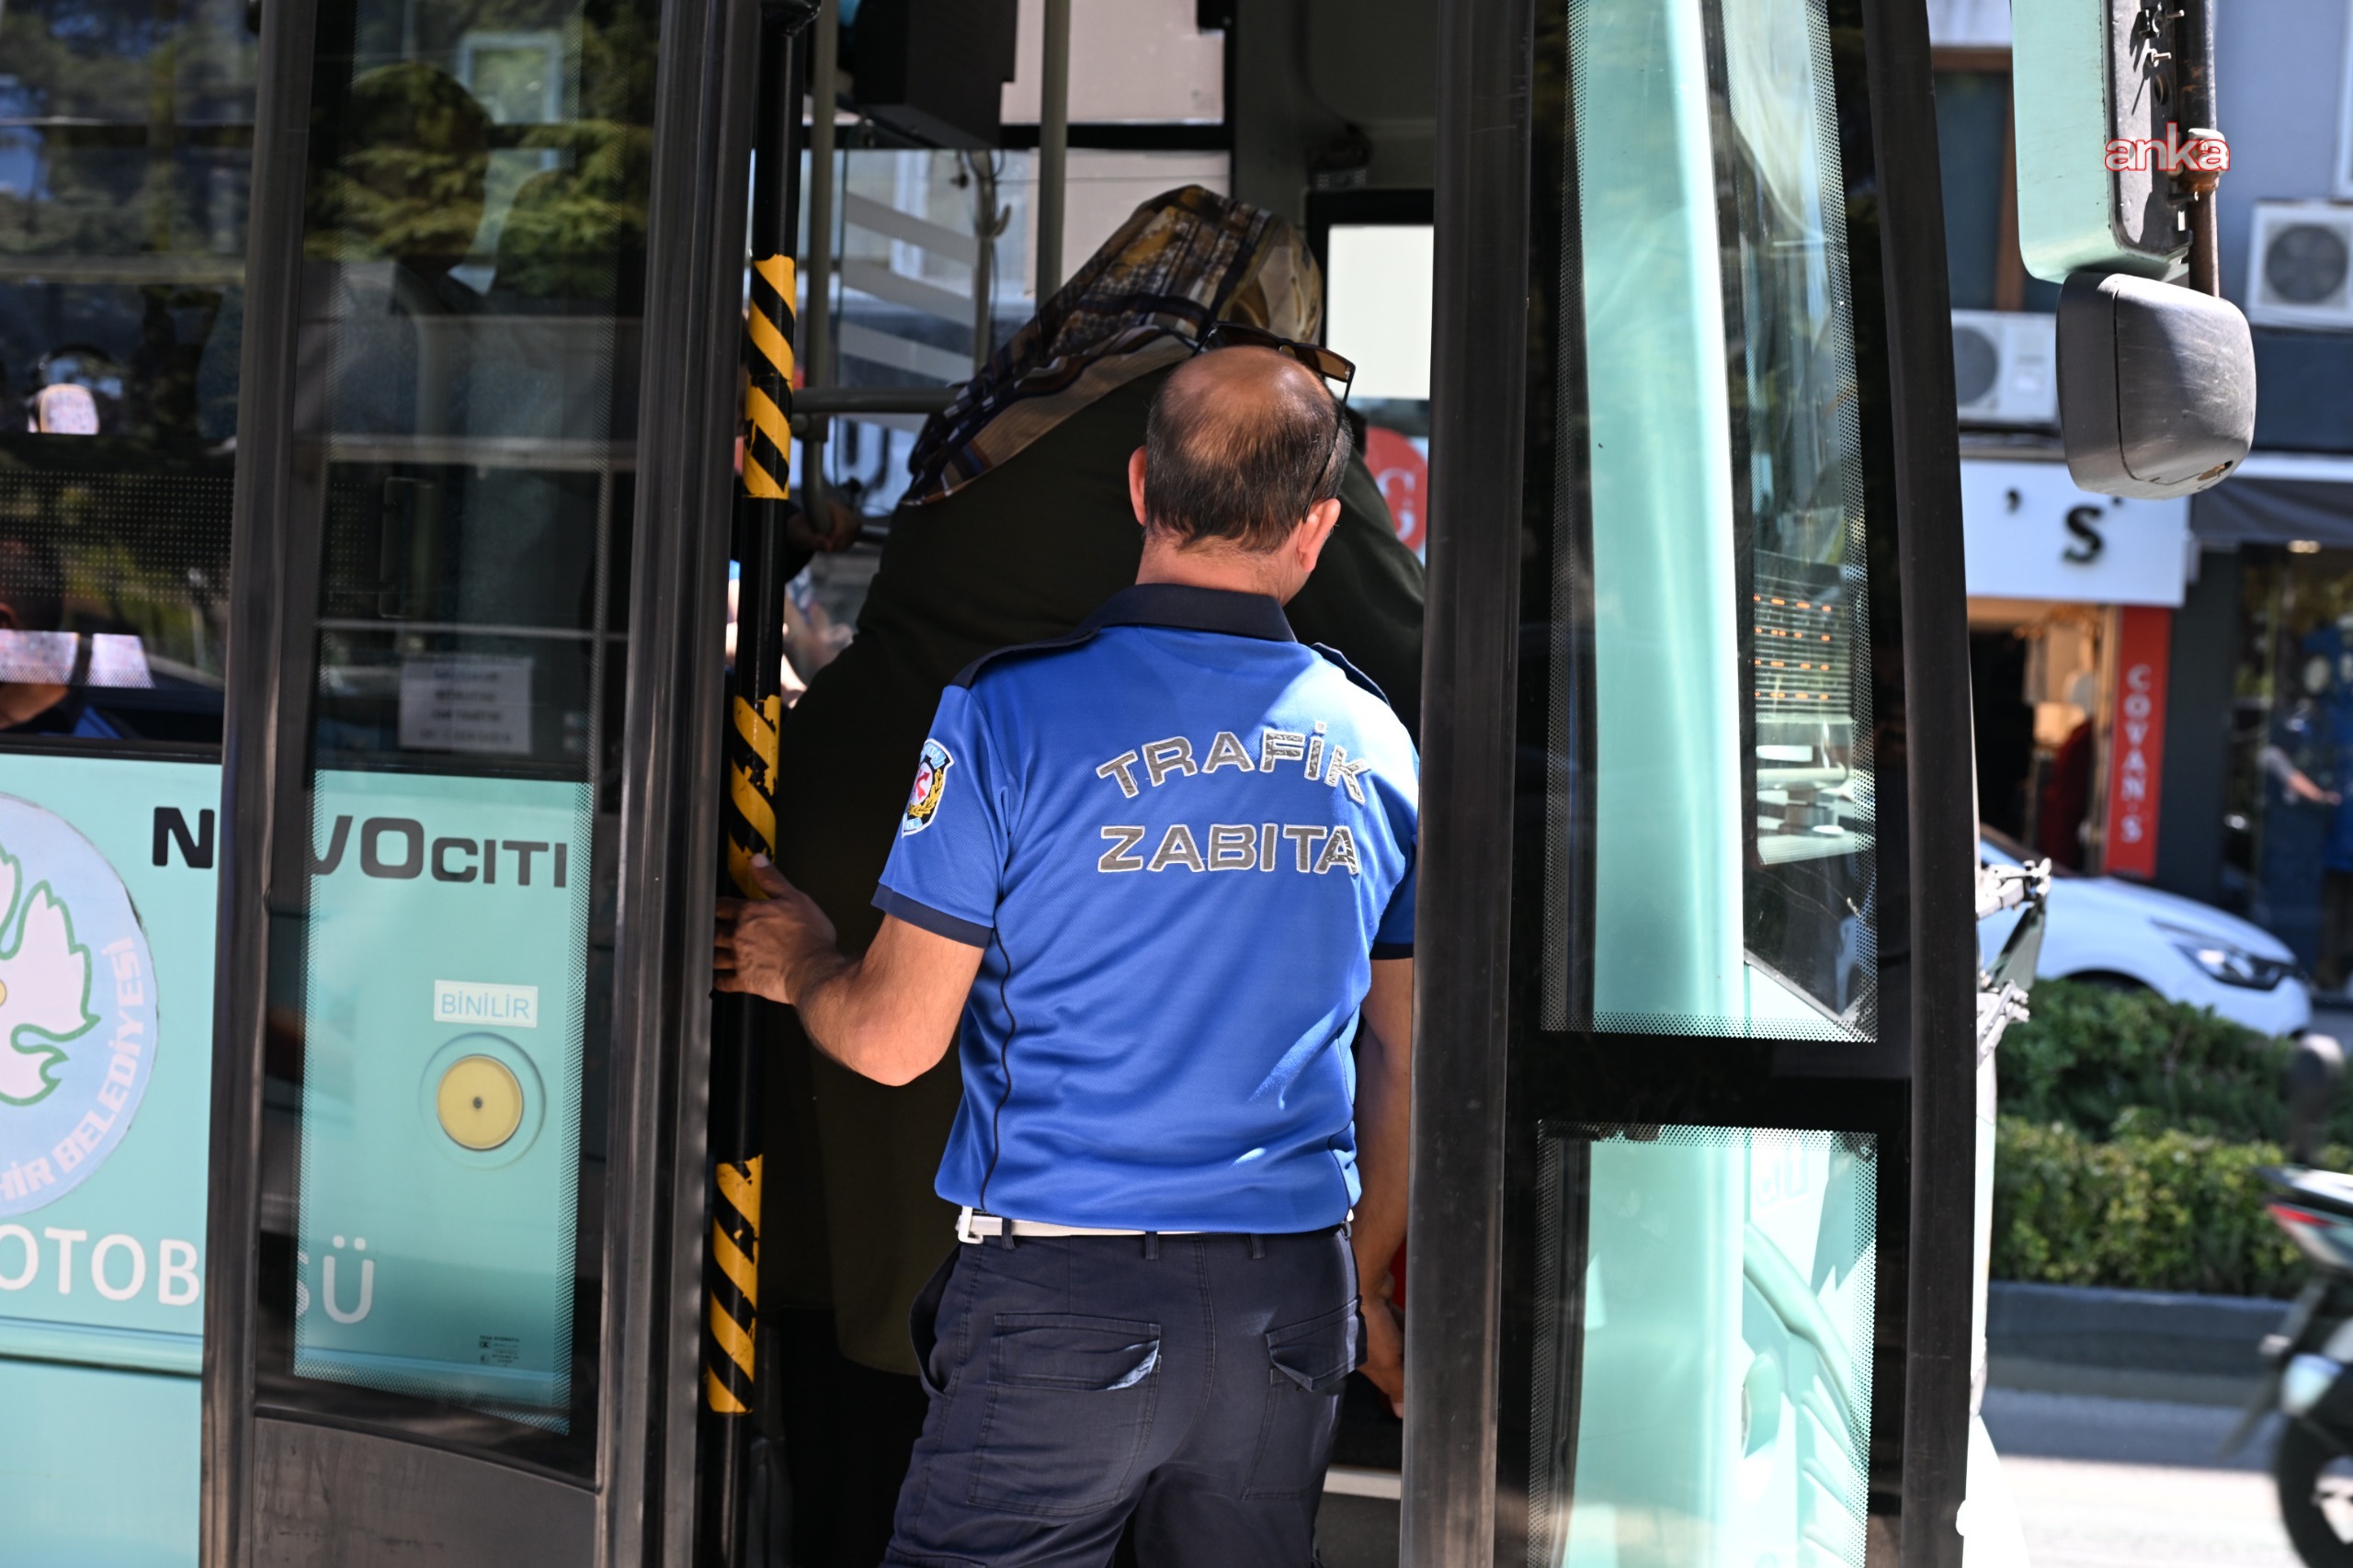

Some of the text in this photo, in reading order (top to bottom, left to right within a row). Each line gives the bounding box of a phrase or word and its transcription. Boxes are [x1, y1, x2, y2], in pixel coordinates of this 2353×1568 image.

[1096, 722, 1371, 806] TRAFİK
[1097, 823, 1360, 876] ZABITA
[441, 991, 530, 1020] BİNİLİR
[51, 937, 144, 1174] BELEDİYESİ
